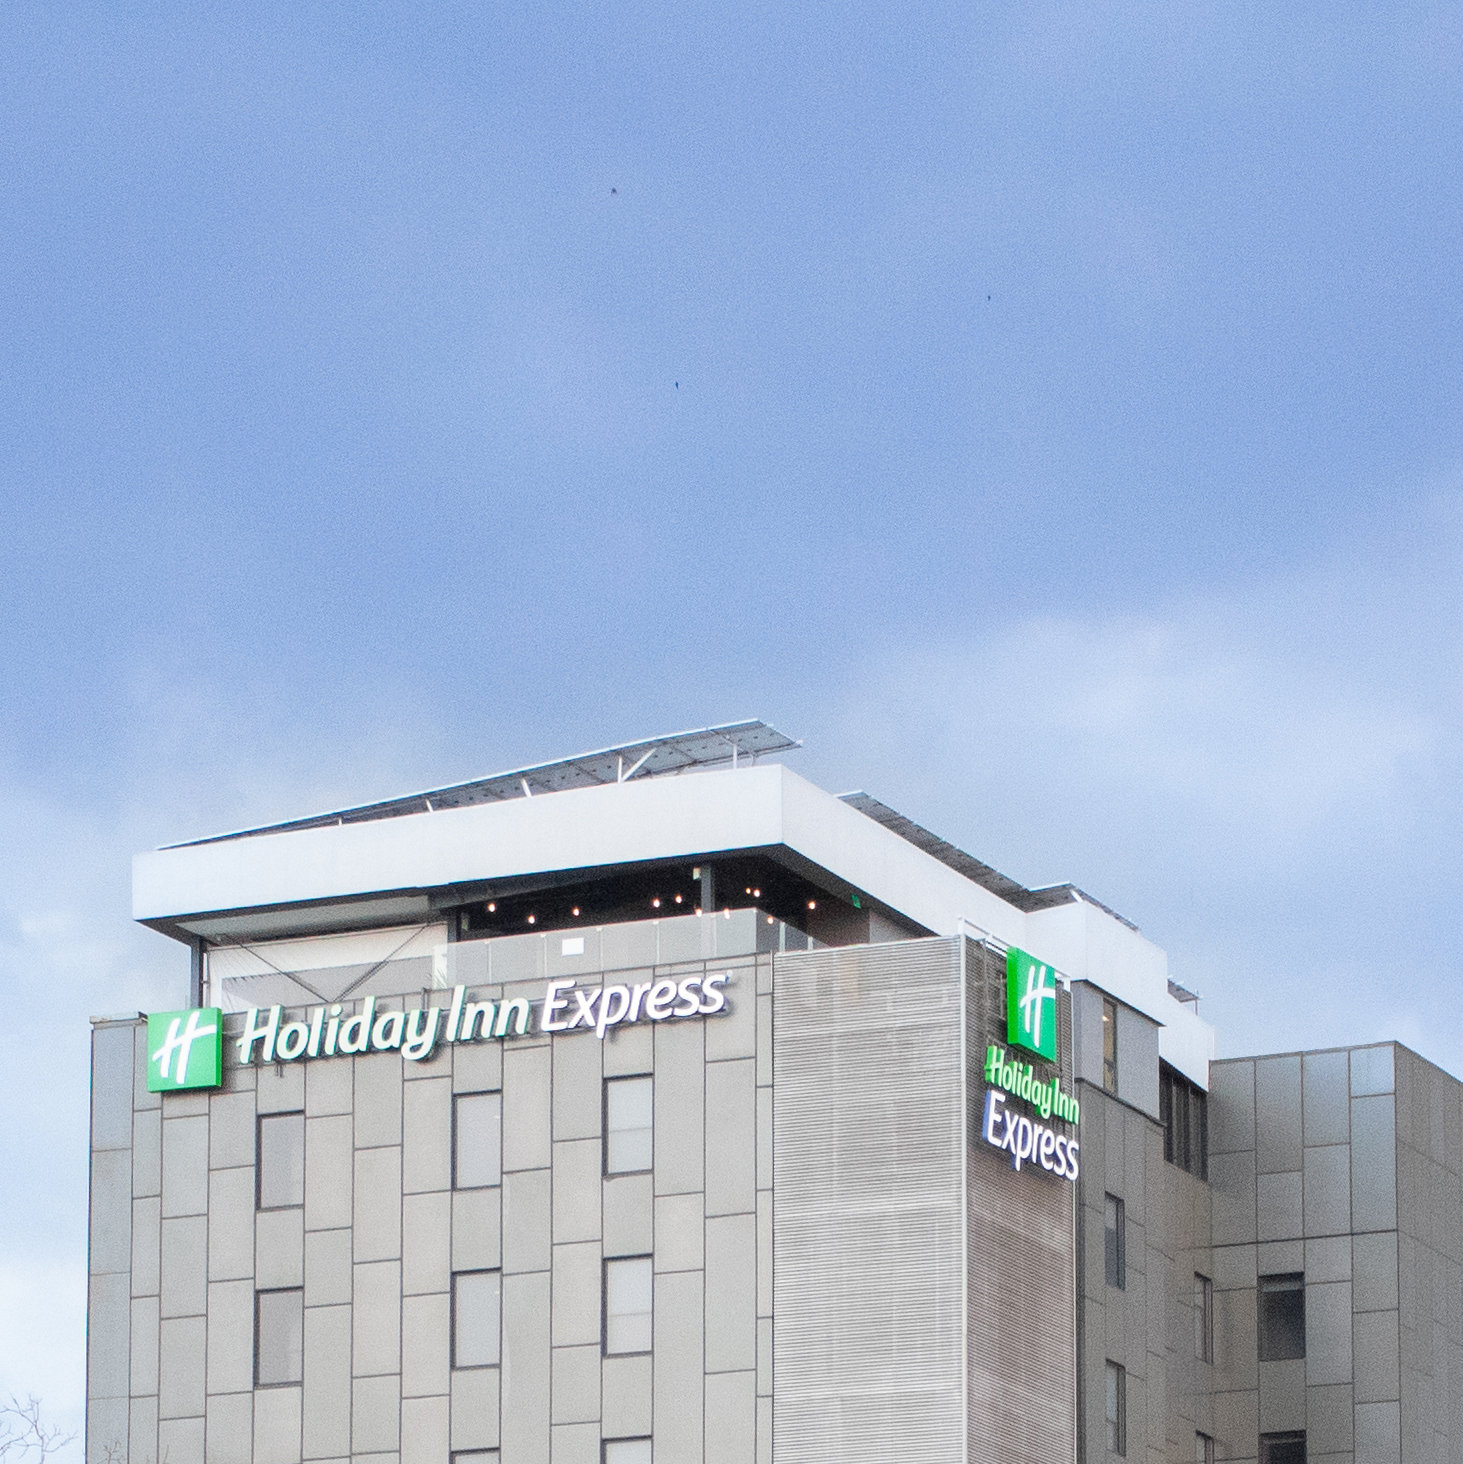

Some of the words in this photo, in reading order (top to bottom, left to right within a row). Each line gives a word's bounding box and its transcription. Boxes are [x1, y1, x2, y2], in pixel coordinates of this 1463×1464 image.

[236, 995, 441, 1065] Holiday
[446, 984, 531, 1042] Inn
[540, 973, 730, 1040] Express
[984, 1044, 1052, 1120] Holiday
[1051, 1077, 1080, 1126] Inn
[982, 1089, 1080, 1182] Express
